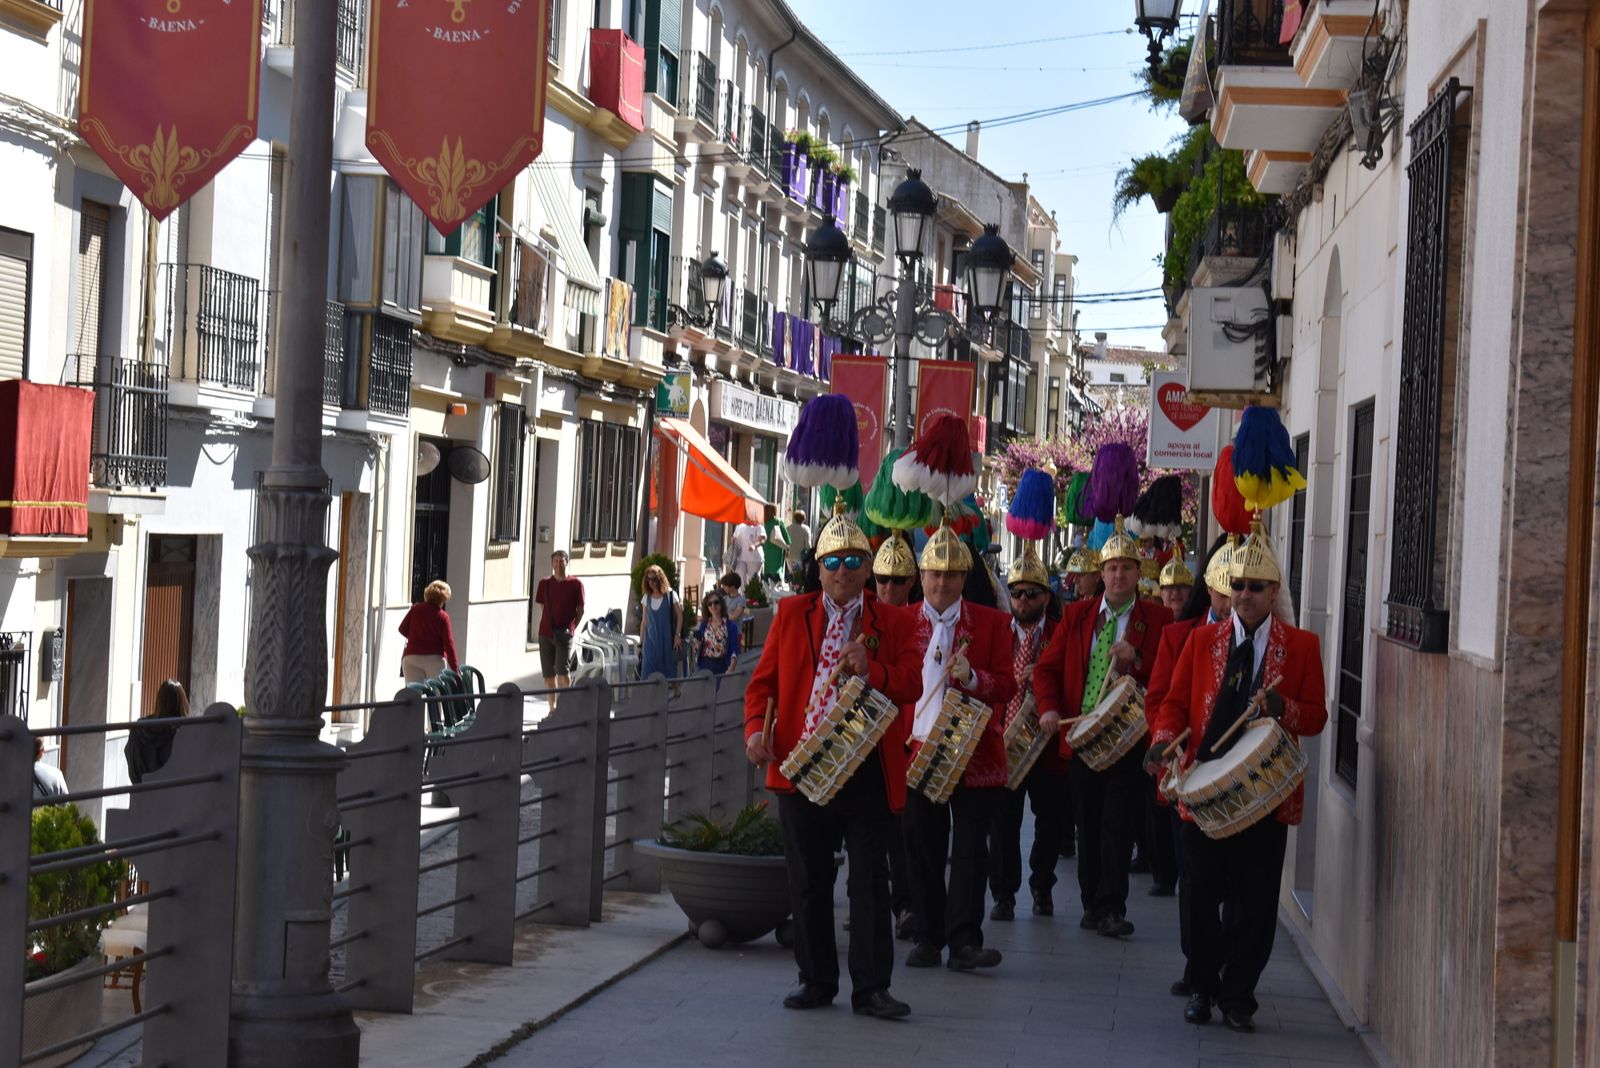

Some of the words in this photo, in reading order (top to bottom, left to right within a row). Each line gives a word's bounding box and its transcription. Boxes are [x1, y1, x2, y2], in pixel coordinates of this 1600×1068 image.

[730, 396, 742, 417] HIPER
[1167, 441, 1192, 450] apoya
[1193, 442, 1200, 450] al
[1154, 450, 1192, 458] comercio
[1193, 451, 1213, 459] local
